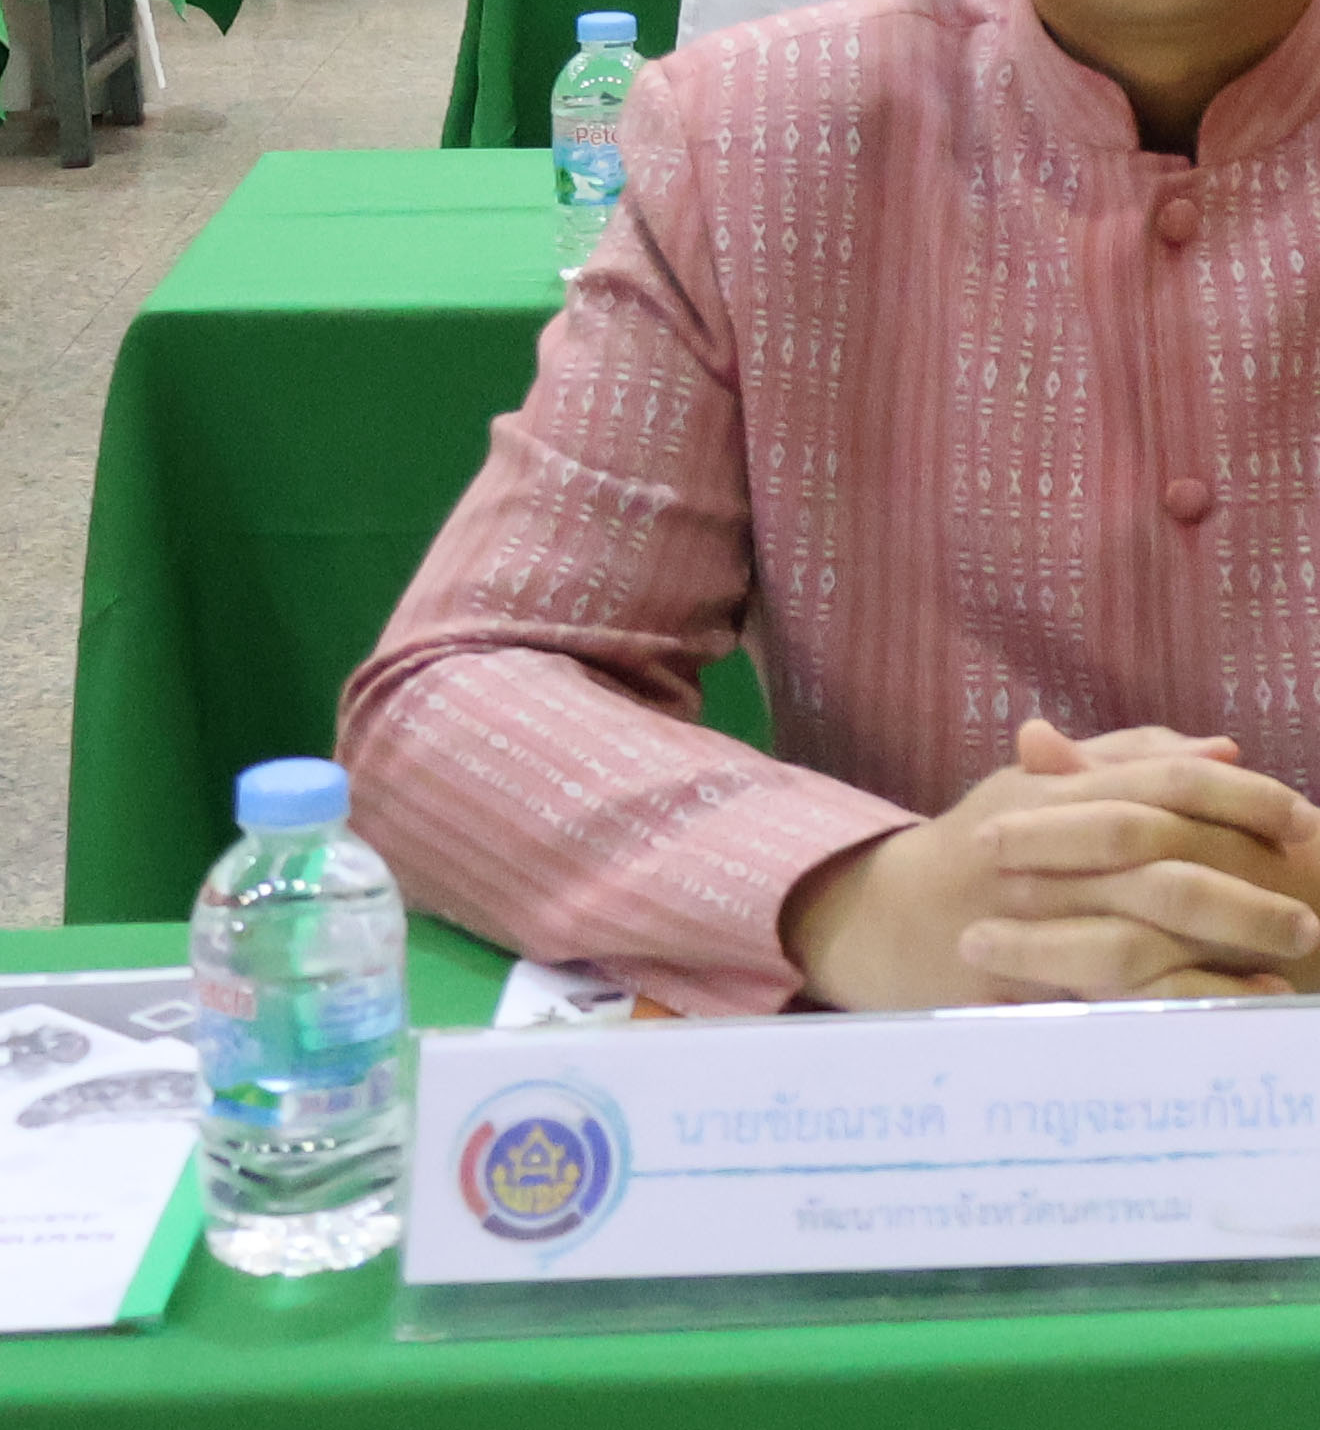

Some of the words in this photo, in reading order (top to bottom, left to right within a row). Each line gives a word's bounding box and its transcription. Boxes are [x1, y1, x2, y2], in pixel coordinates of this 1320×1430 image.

[671, 1071, 952, 1146] นายชัยณรงค์
